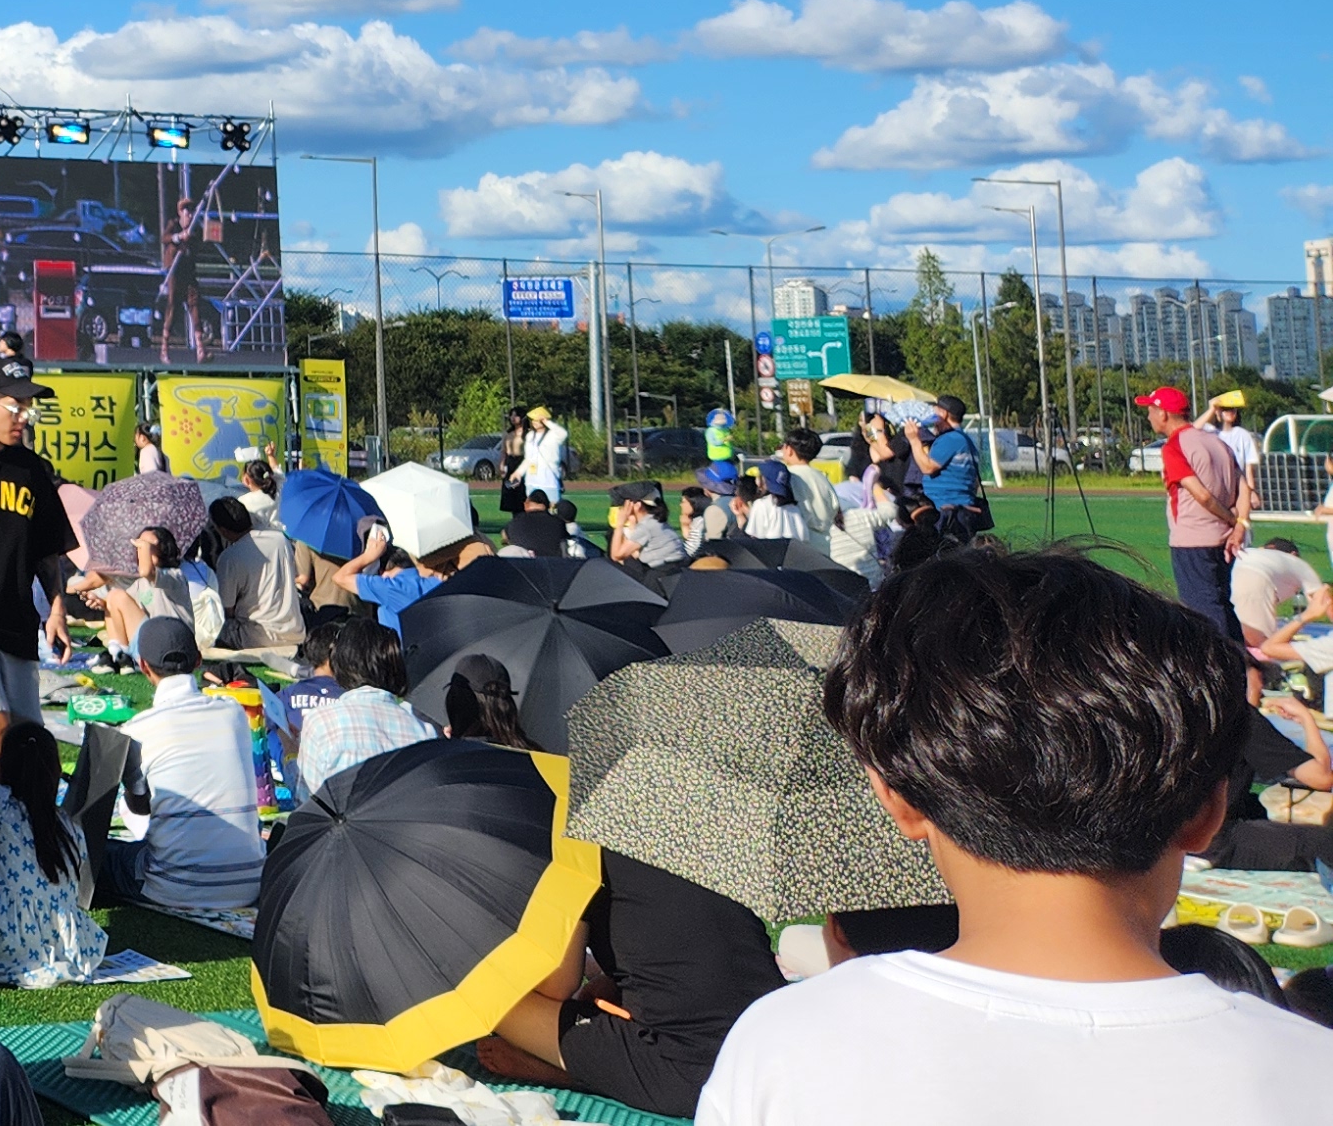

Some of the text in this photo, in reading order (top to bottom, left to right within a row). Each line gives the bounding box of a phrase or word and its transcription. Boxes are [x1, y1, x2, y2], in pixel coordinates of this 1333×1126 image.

[40, 294, 70, 305] POST
[69, 405, 86, 418] 20
[89, 394, 117, 427] 작
[38, 429, 118, 463] 서커스
